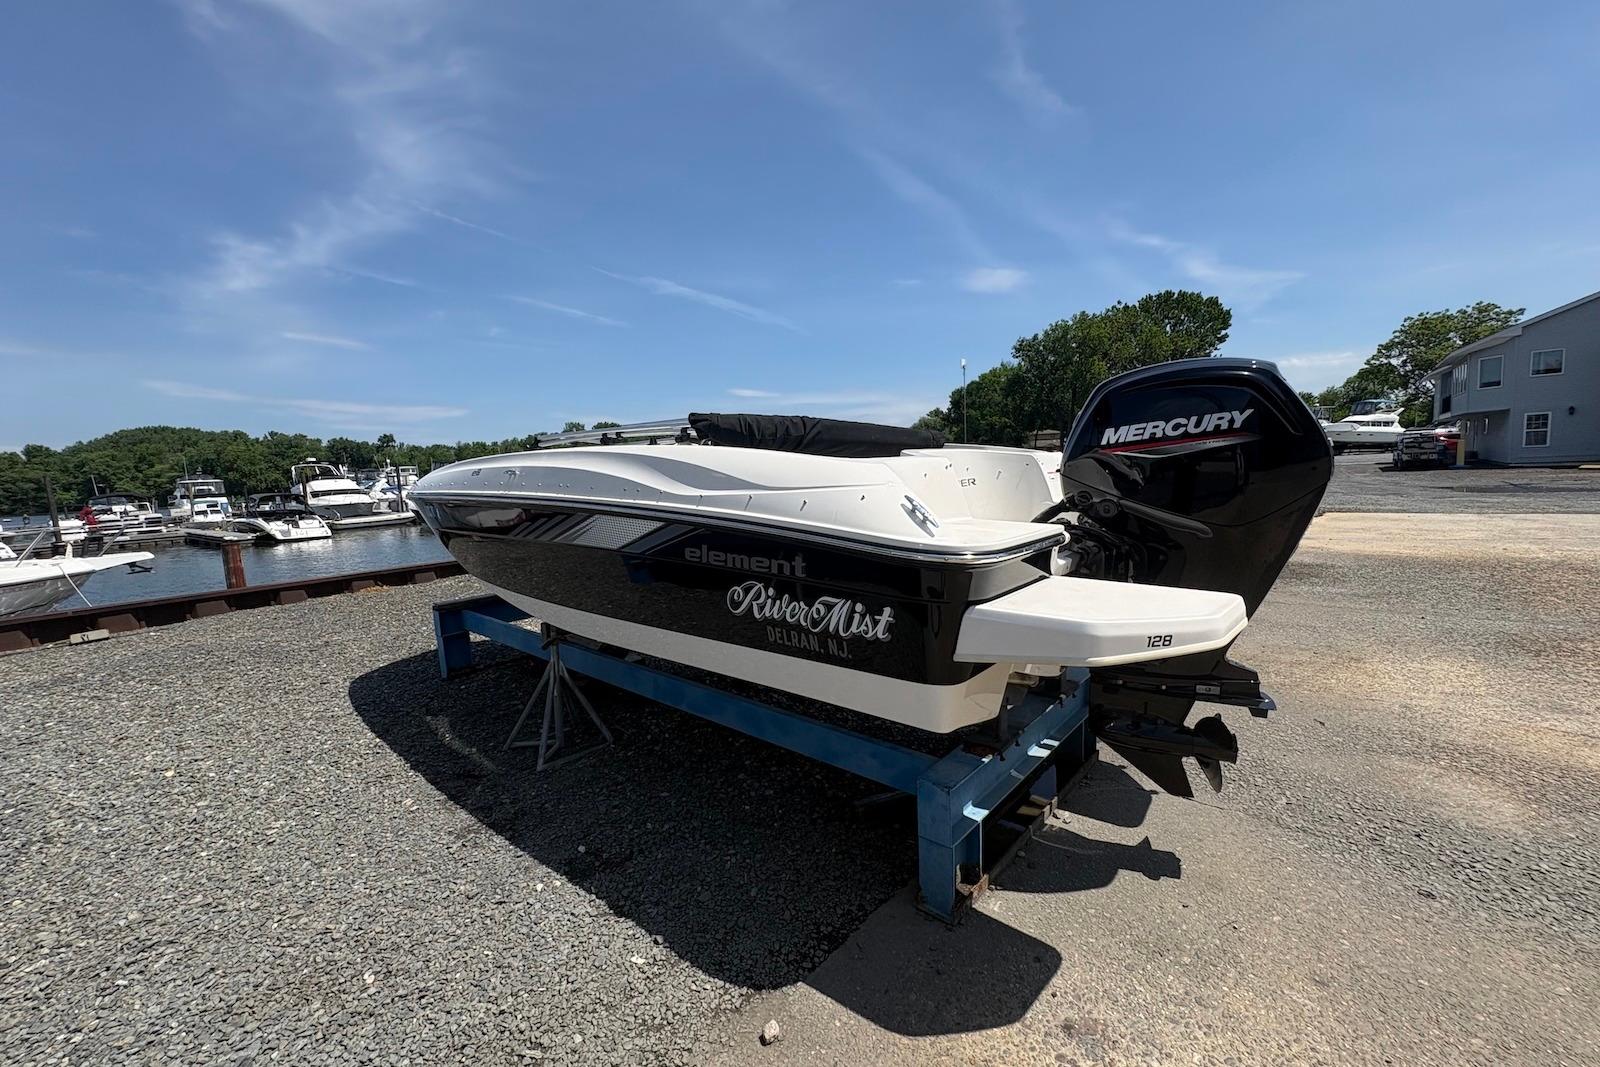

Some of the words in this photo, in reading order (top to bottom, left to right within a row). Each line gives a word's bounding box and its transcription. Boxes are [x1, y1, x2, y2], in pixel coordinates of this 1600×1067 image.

[1101, 408, 1255, 446] MERCURY
[684, 544, 807, 578] element
[1147, 635, 1173, 648] 128
